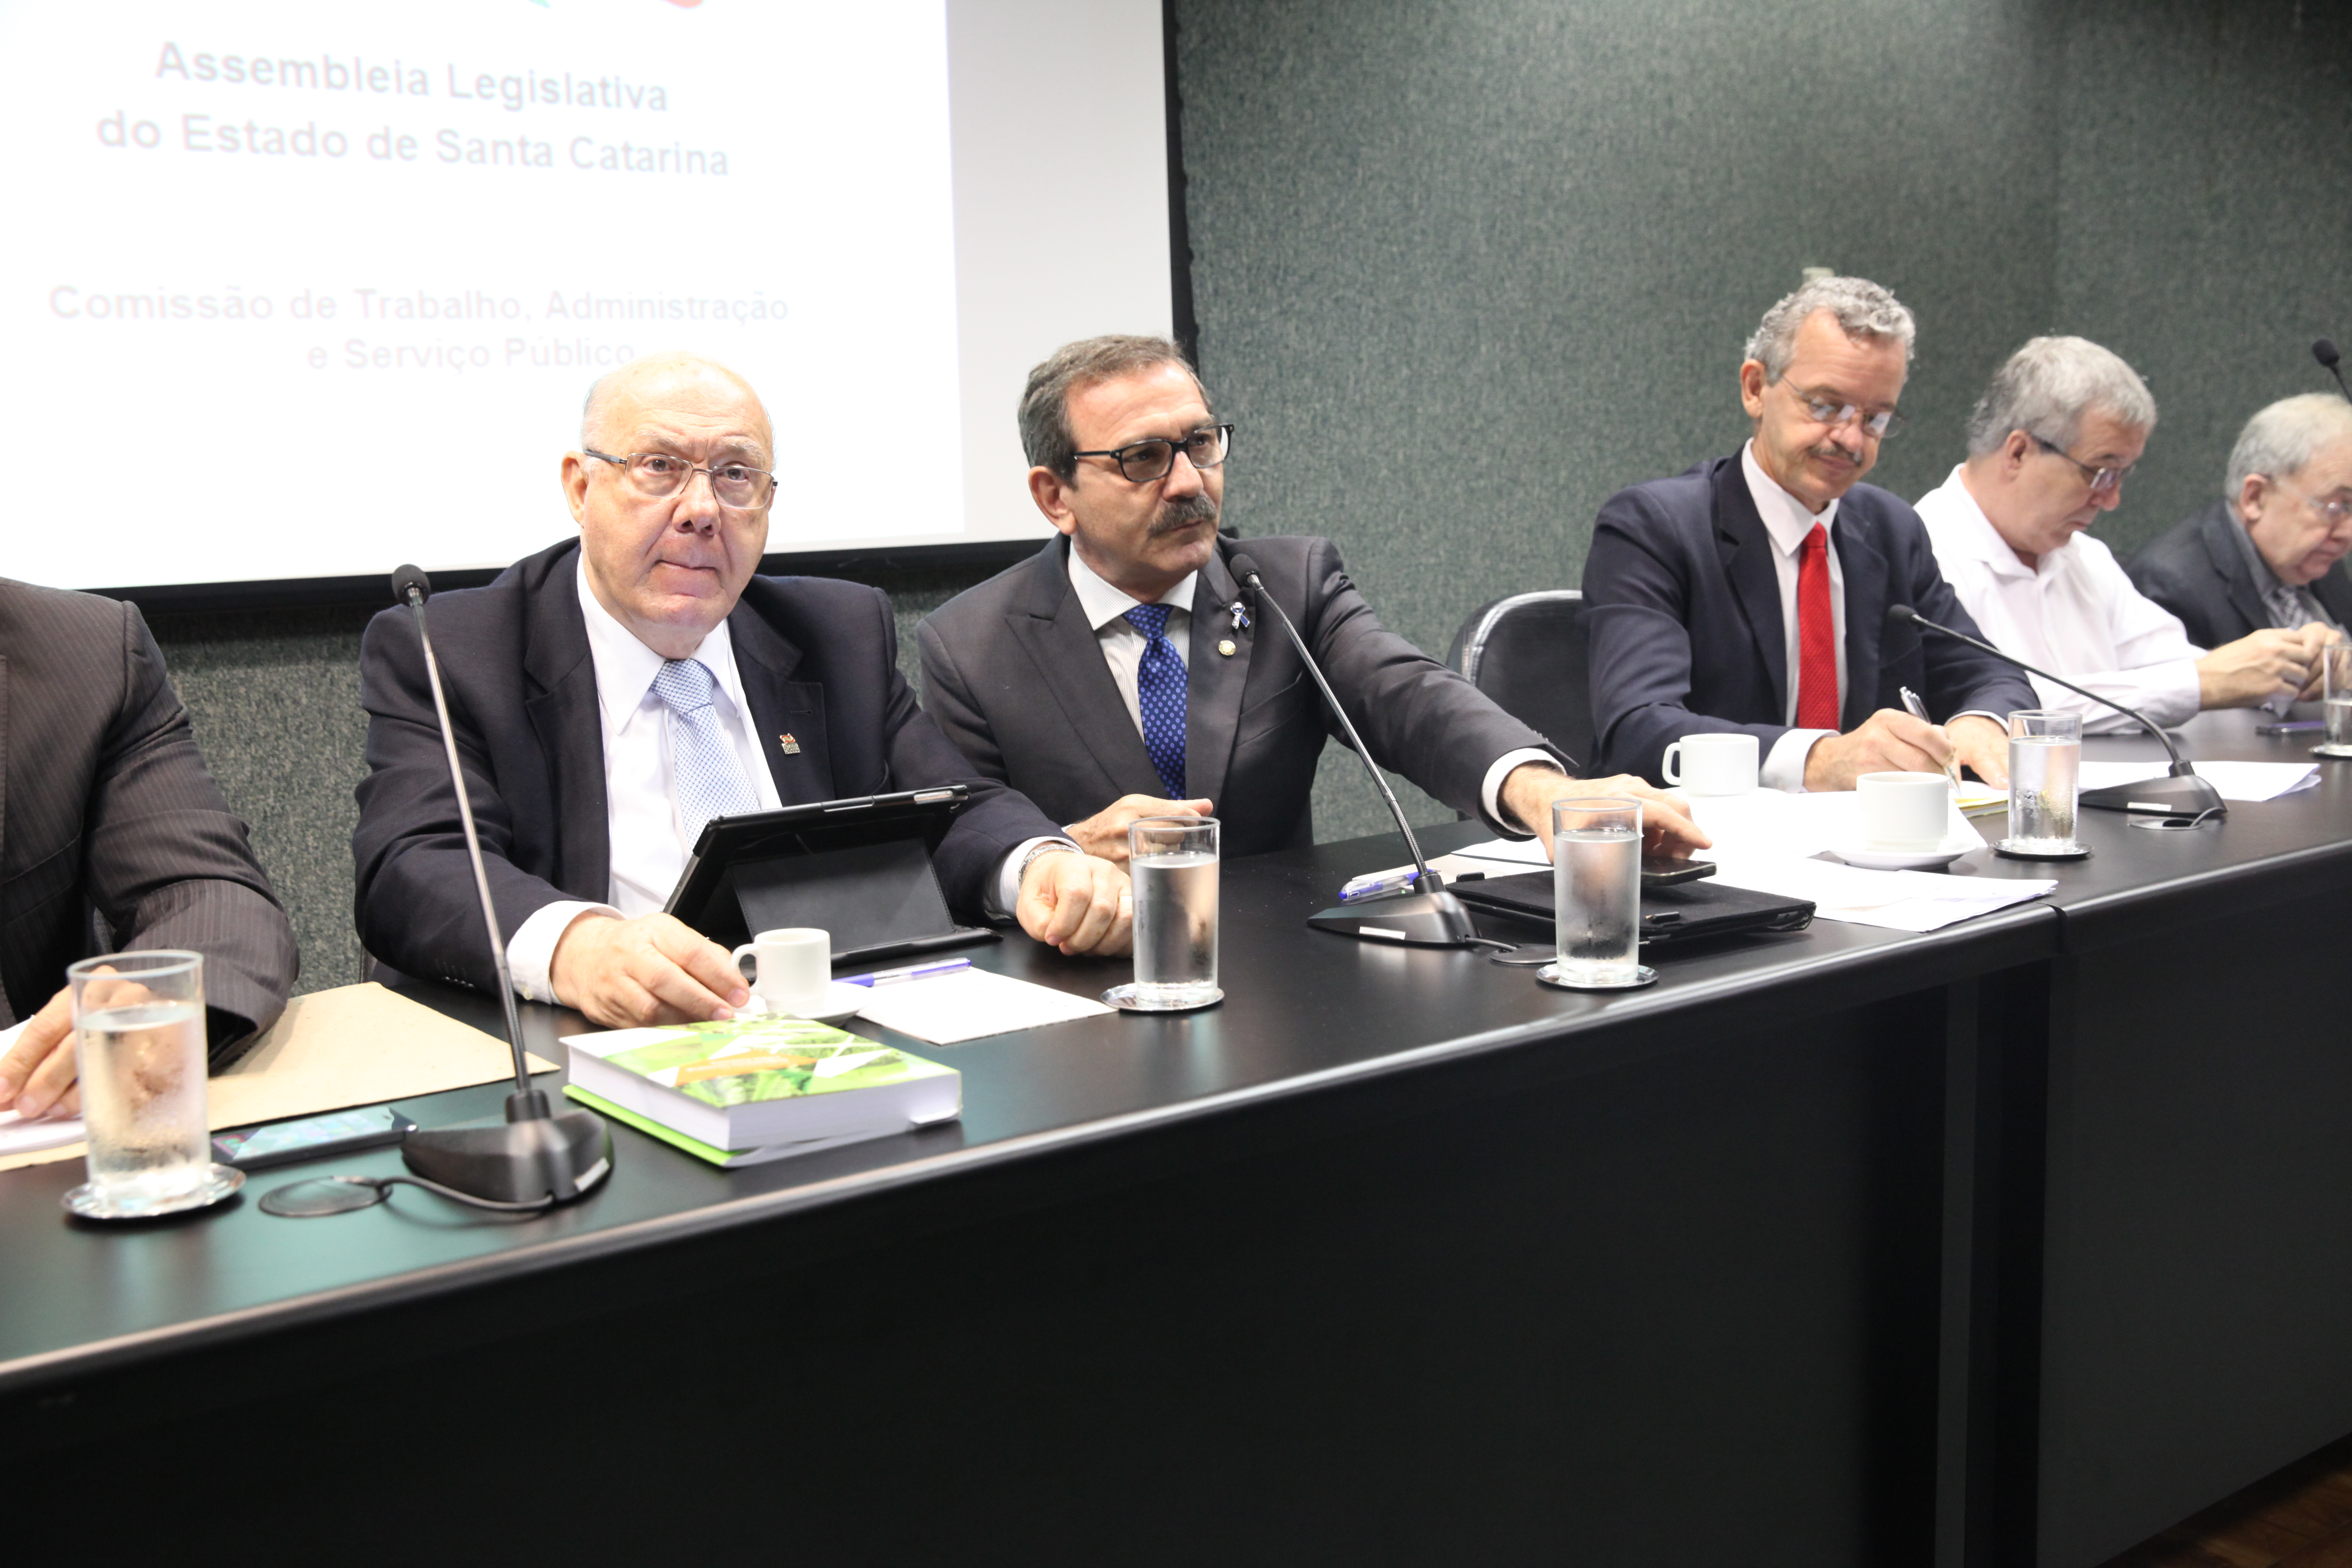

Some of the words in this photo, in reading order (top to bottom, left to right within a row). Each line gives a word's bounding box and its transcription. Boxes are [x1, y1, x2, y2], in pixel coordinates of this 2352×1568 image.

[155, 40, 431, 97] Assembleia
[447, 62, 668, 113] Legislativa
[96, 109, 162, 150] do
[181, 113, 349, 158] Estado
[366, 125, 419, 162] de
[436, 128, 554, 168] Santa
[569, 135, 729, 176] Catarina
[49, 283, 273, 319] Comissão
[290, 289, 337, 319] de
[353, 287, 530, 323] Trabalho,
[546, 291, 788, 325] Administração
[308, 347, 328, 369] e
[345, 338, 490, 375] Serviço
[505, 335, 635, 366] Público
